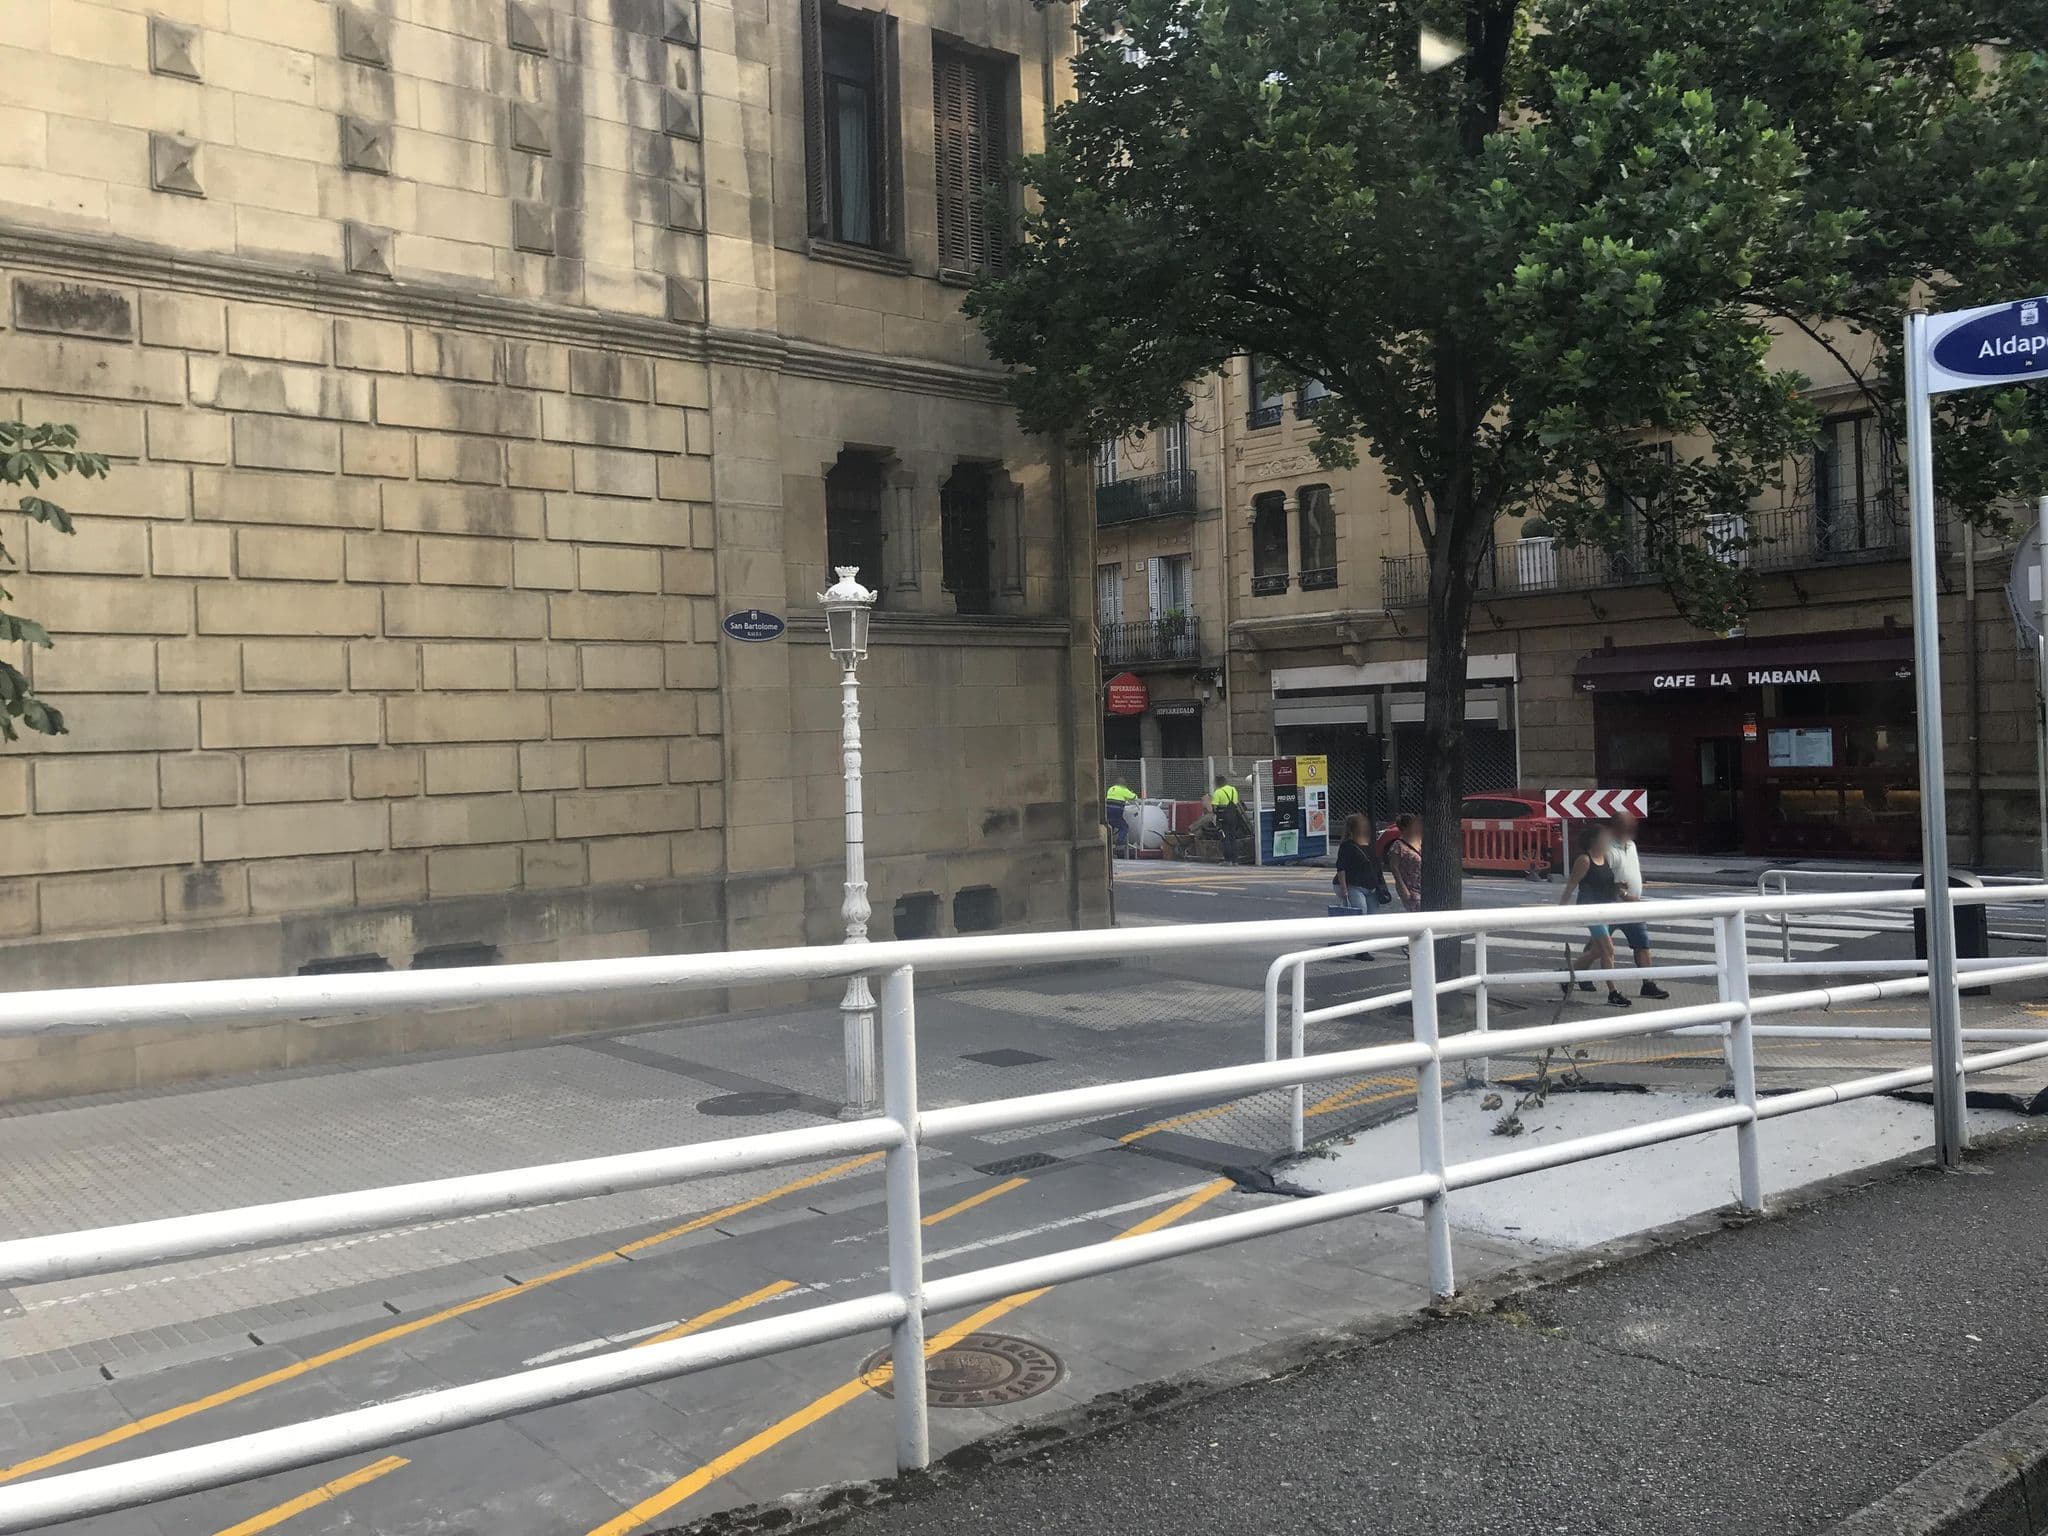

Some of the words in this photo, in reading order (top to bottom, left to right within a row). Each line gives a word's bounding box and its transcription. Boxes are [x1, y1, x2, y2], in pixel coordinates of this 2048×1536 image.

[1978, 334, 2048, 359] Aldap
[744, 622, 778, 630] Bartolome
[1653, 674, 1696, 688] CAFE
[1710, 673, 1732, 686] LA
[1748, 669, 1821, 685] HABANA
